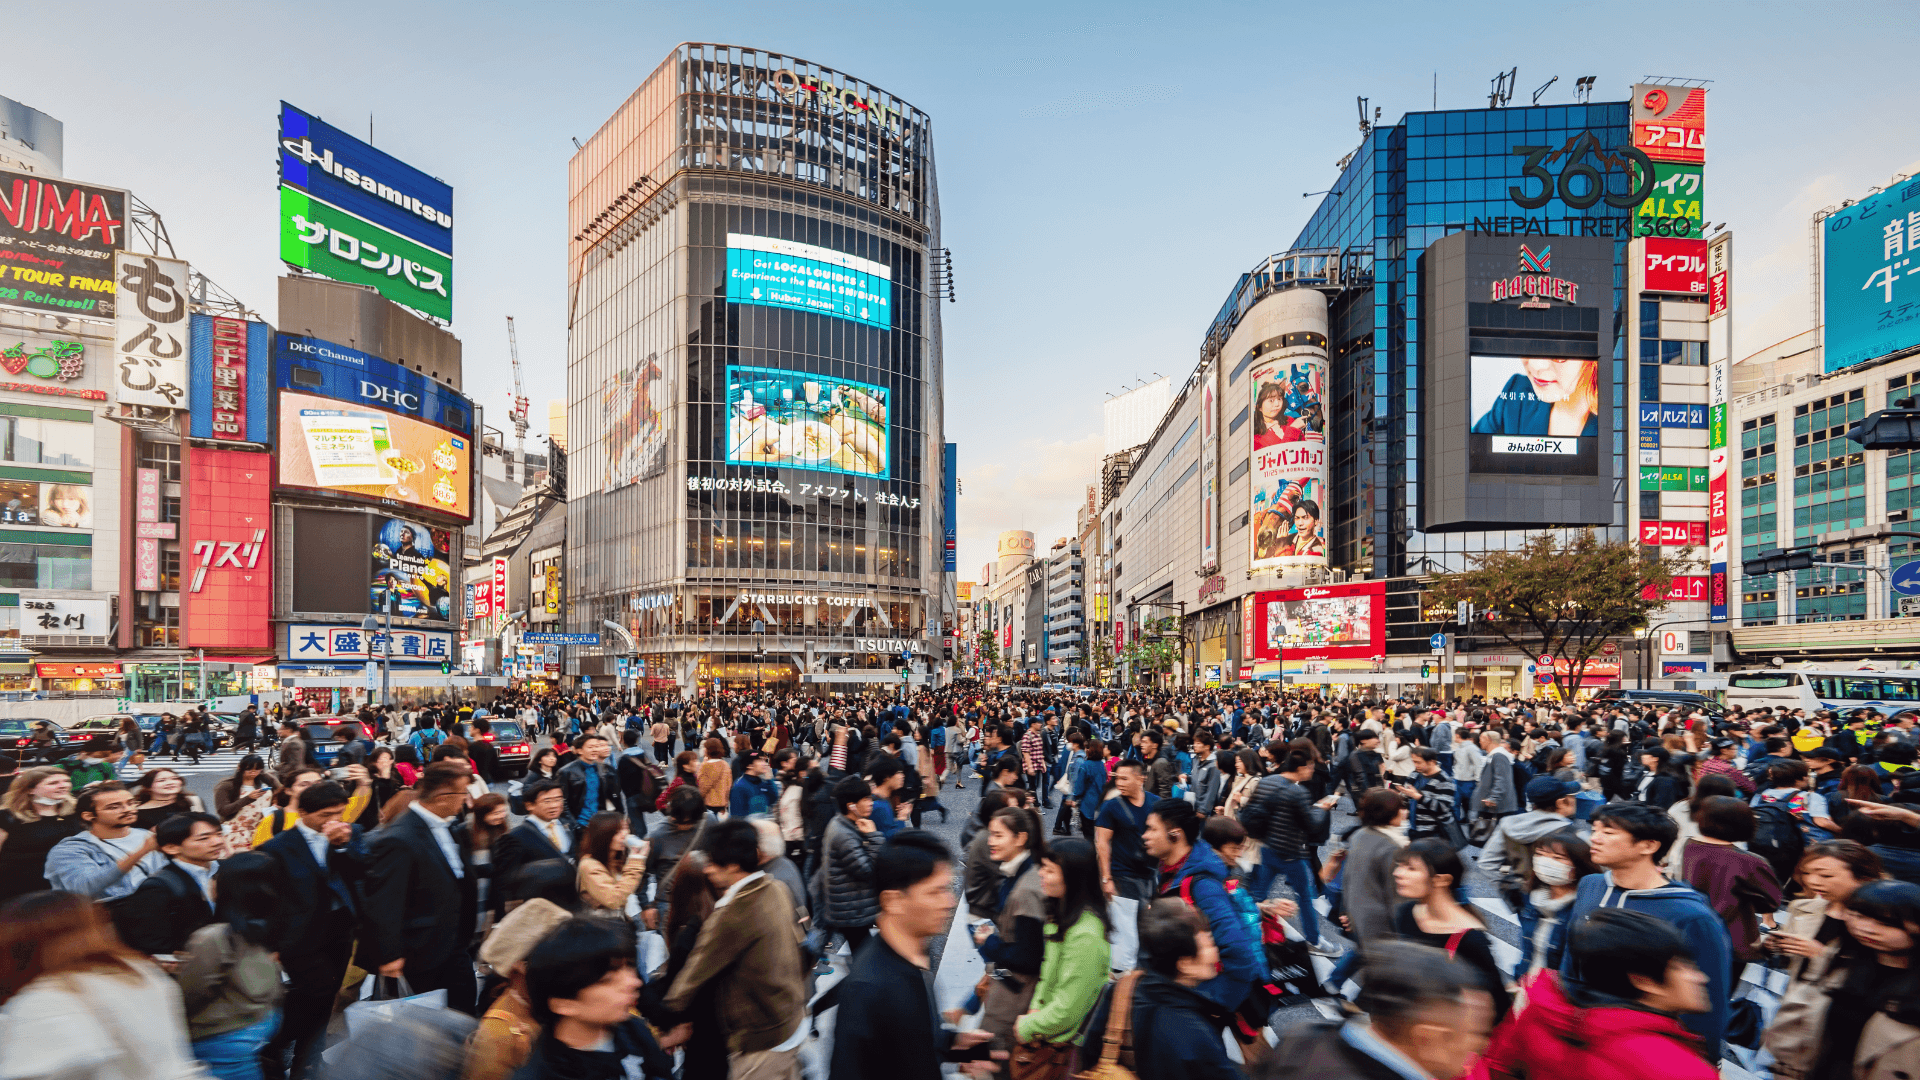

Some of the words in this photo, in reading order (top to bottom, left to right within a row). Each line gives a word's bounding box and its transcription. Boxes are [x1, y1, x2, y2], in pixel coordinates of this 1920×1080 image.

[1645, 125, 1705, 149] アコム
[1639, 198, 1700, 220] ALSA
[292, 214, 447, 297] サロンパス
[1647, 254, 1705, 273] アイフル
[11, 266, 65, 286] TOUR
[732, 268, 787, 284] Experience
[790, 276, 805, 286] the
[808, 279, 837, 293] REAL
[753, 259, 772, 269] Get
[774, 262, 812, 276] LOCAL
[813, 269, 856, 286] GUIDES
[859, 280, 866, 288] &
[1492, 275, 1579, 304] MAGNET
[806, 297, 835, 311] Japan
[120, 258, 184, 404] もんじゃ
[290, 342, 317, 354] DHC
[319, 348, 364, 366] Channel
[213, 320, 239, 434] 三千里薬品
[360, 380, 418, 411] DHC
[1641, 409, 1703, 423] レオパレス21
[1257, 447, 1324, 471] ジャパンカップ
[1507, 441, 1562, 453] みんなのFX
[1712, 491, 1725, 517] アコム
[1645, 526, 1688, 540] アコム
[389, 558, 436, 577] Planets
[396, 553, 425, 565] teamLab
[741, 594, 818, 605] STARBUCKS
[826, 597, 870, 608] COFFEE
[300, 632, 447, 656] 大盛堂書店
[857, 638, 920, 653] TSUTAYA
